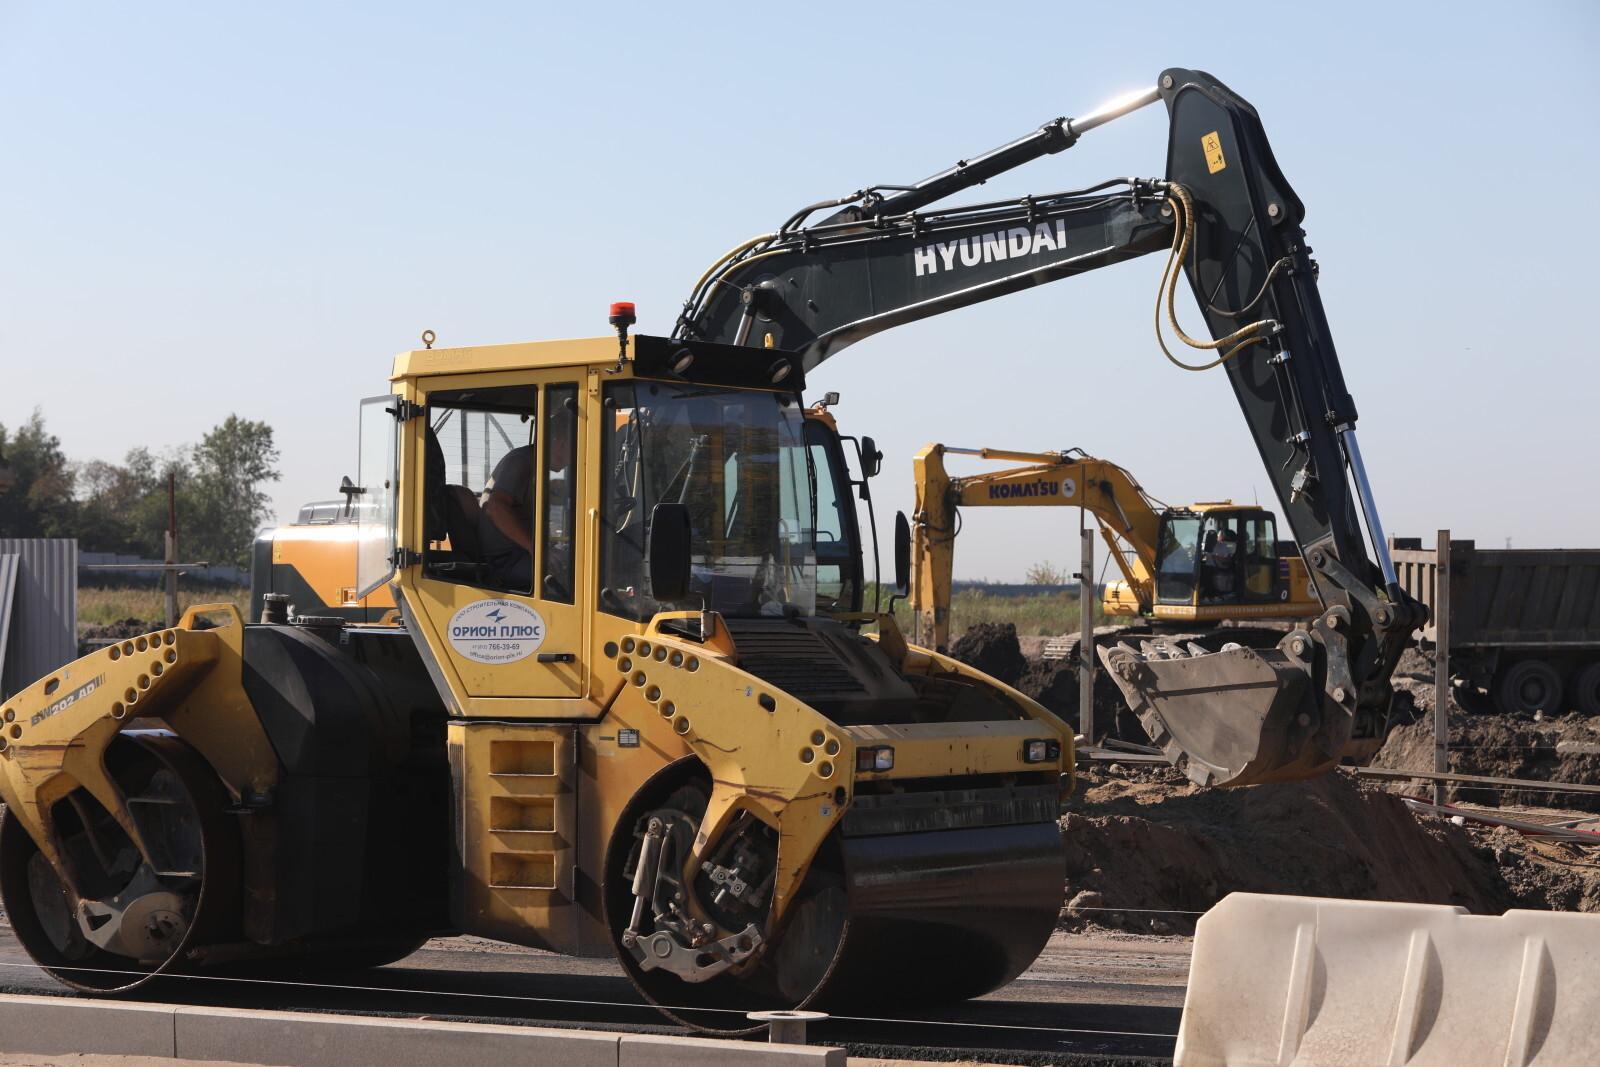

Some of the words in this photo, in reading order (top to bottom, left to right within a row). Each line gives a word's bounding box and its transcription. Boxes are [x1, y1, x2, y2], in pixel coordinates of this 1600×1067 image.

[914, 219, 1067, 277] HYUNDAI
[989, 481, 1058, 499] KOMATSU
[452, 626, 497, 637] ОРИОН
[500, 625, 540, 637] ПЛЮС
